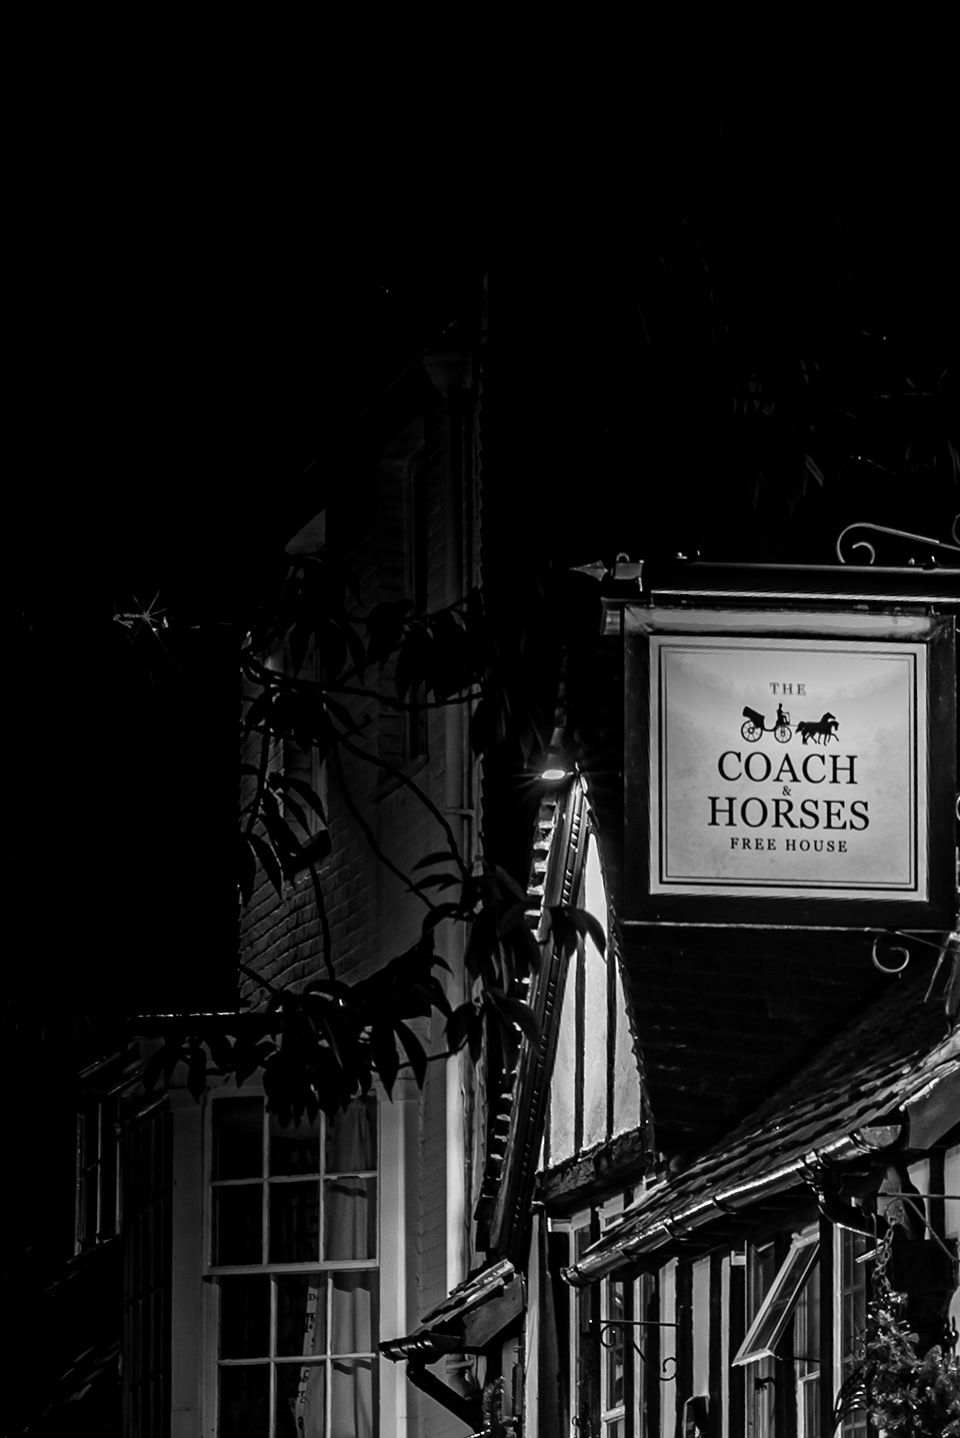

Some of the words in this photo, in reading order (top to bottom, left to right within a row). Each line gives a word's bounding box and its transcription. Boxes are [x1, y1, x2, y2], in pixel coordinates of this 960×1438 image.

[770, 683, 806, 695] THE
[718, 751, 857, 784] COACH
[782, 785, 792, 796] &
[708, 797, 869, 830] HORSES
[730, 838, 776, 850] FREE
[786, 839, 848, 852] HOUSE
